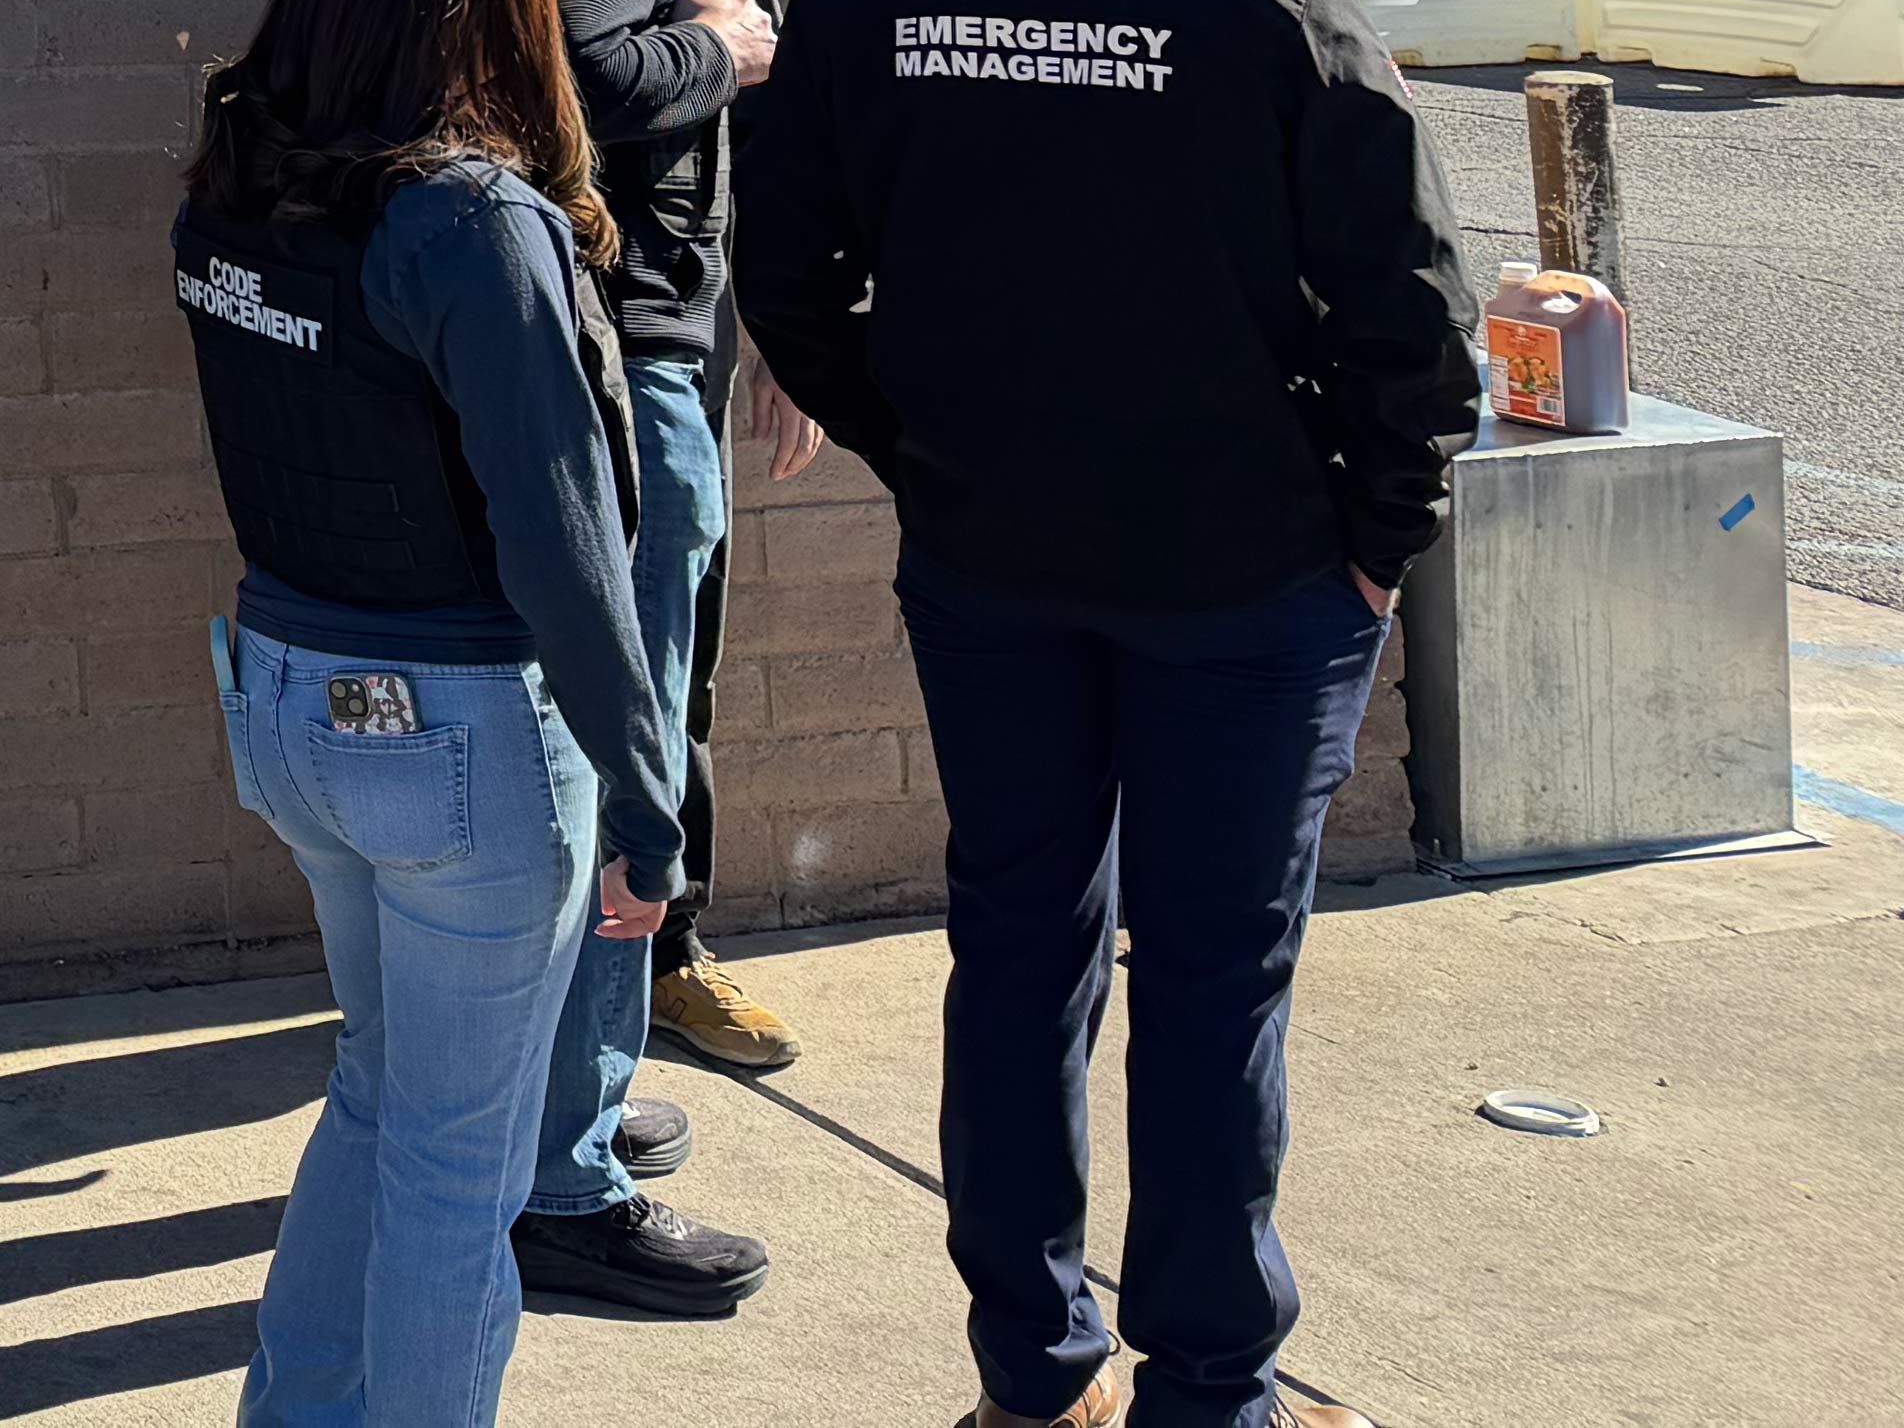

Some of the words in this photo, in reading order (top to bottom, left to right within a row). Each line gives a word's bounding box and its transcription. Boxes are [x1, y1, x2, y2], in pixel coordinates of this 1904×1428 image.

[894, 15, 1173, 60] EMERGENCY
[894, 49, 1173, 93] MANAGEMENT
[208, 256, 263, 304] CODE
[176, 268, 322, 352] ENFORCEMENT
